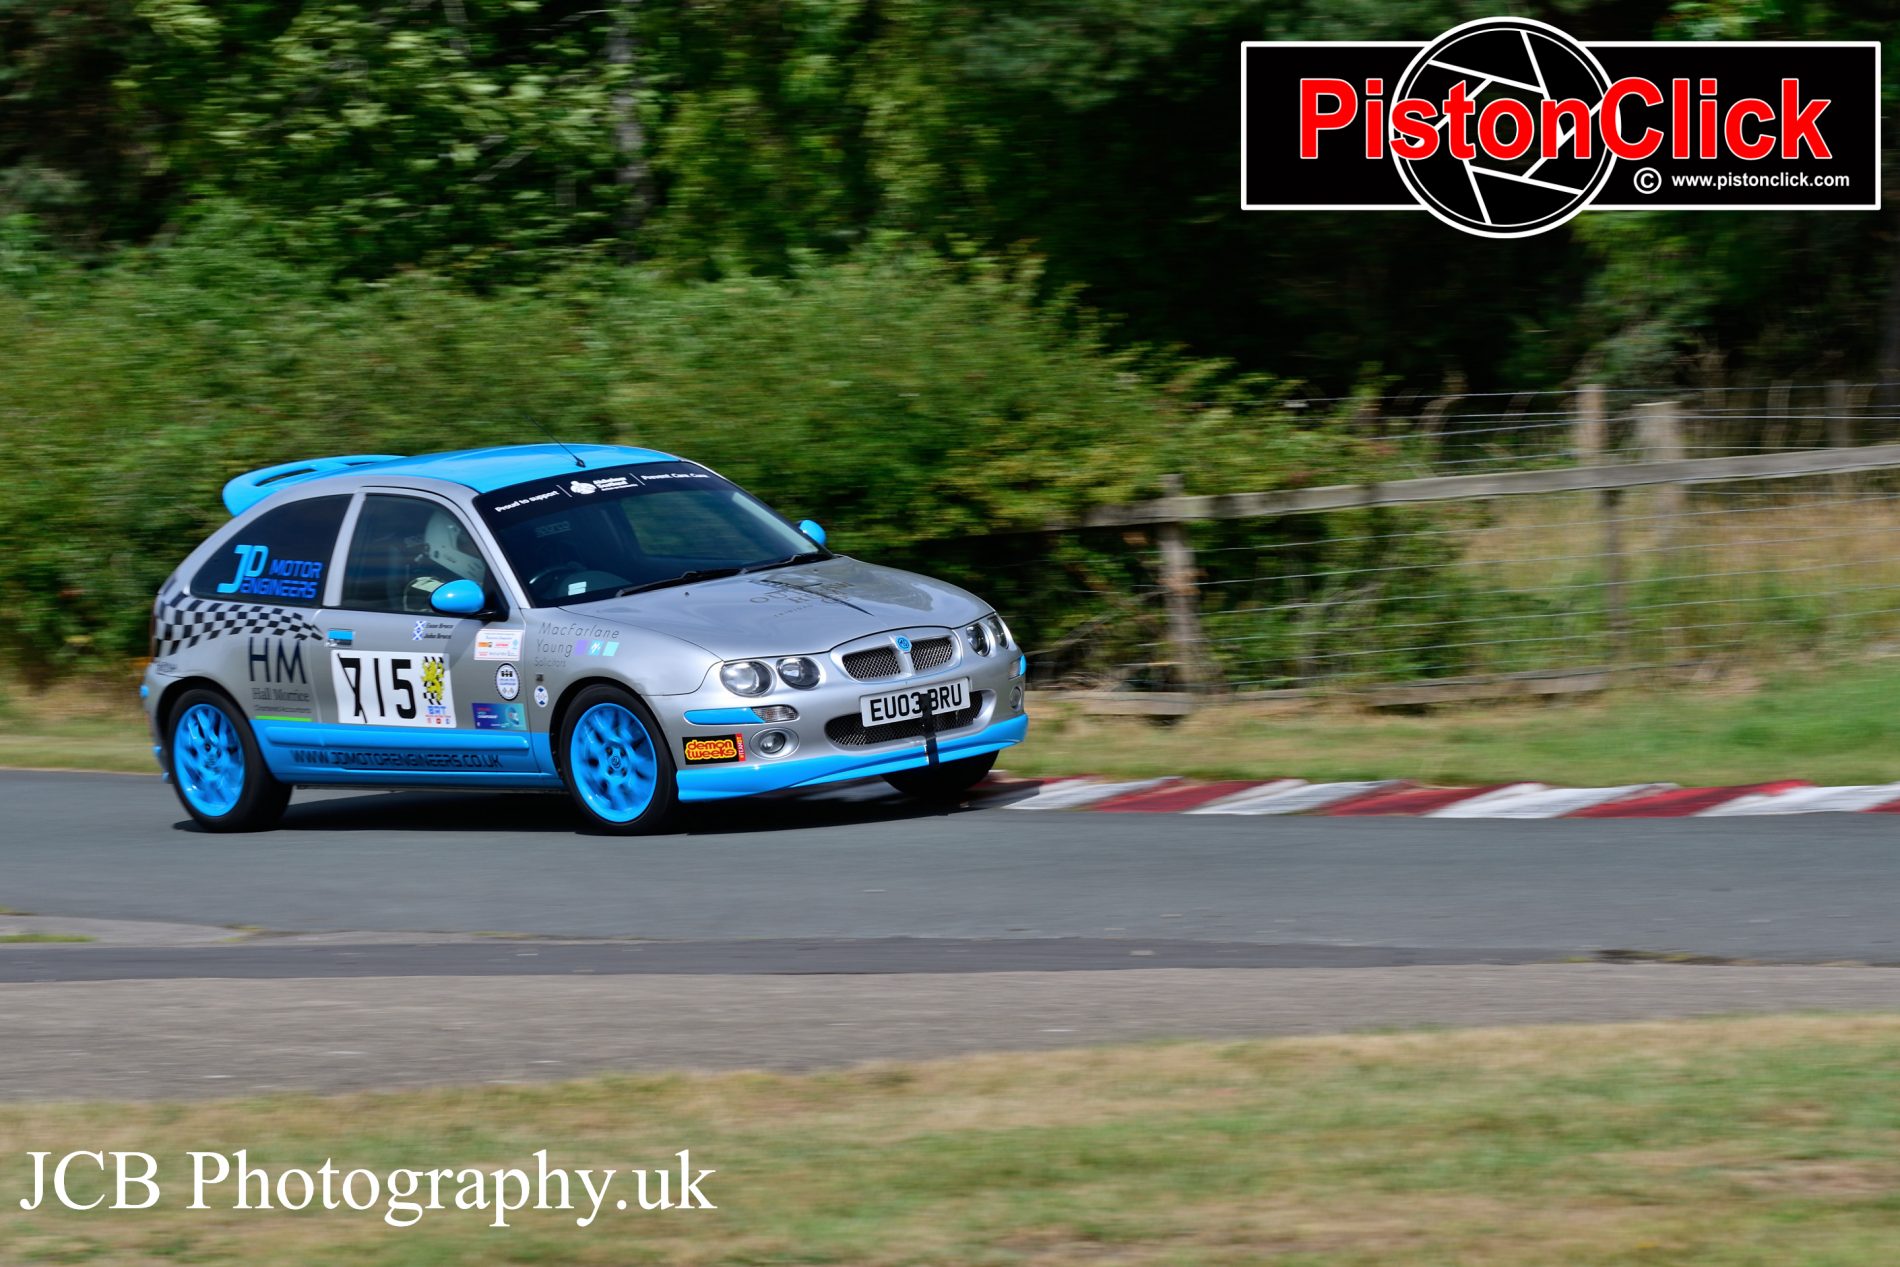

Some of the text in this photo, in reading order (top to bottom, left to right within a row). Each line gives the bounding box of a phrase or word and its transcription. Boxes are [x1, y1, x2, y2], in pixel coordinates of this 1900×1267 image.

[495, 501, 521, 512] Proud
[529, 490, 560, 502] support
[269, 559, 323, 579] MOTOR
[240, 577, 317, 599] ENGINEERS
[536, 639, 573, 658] Young
[248, 636, 307, 684] HM
[251, 687, 272, 700] Hall
[869, 682, 963, 722] EU03 BRU
[686, 739, 734, 751] demon
[686, 748, 736, 760] tweeks
